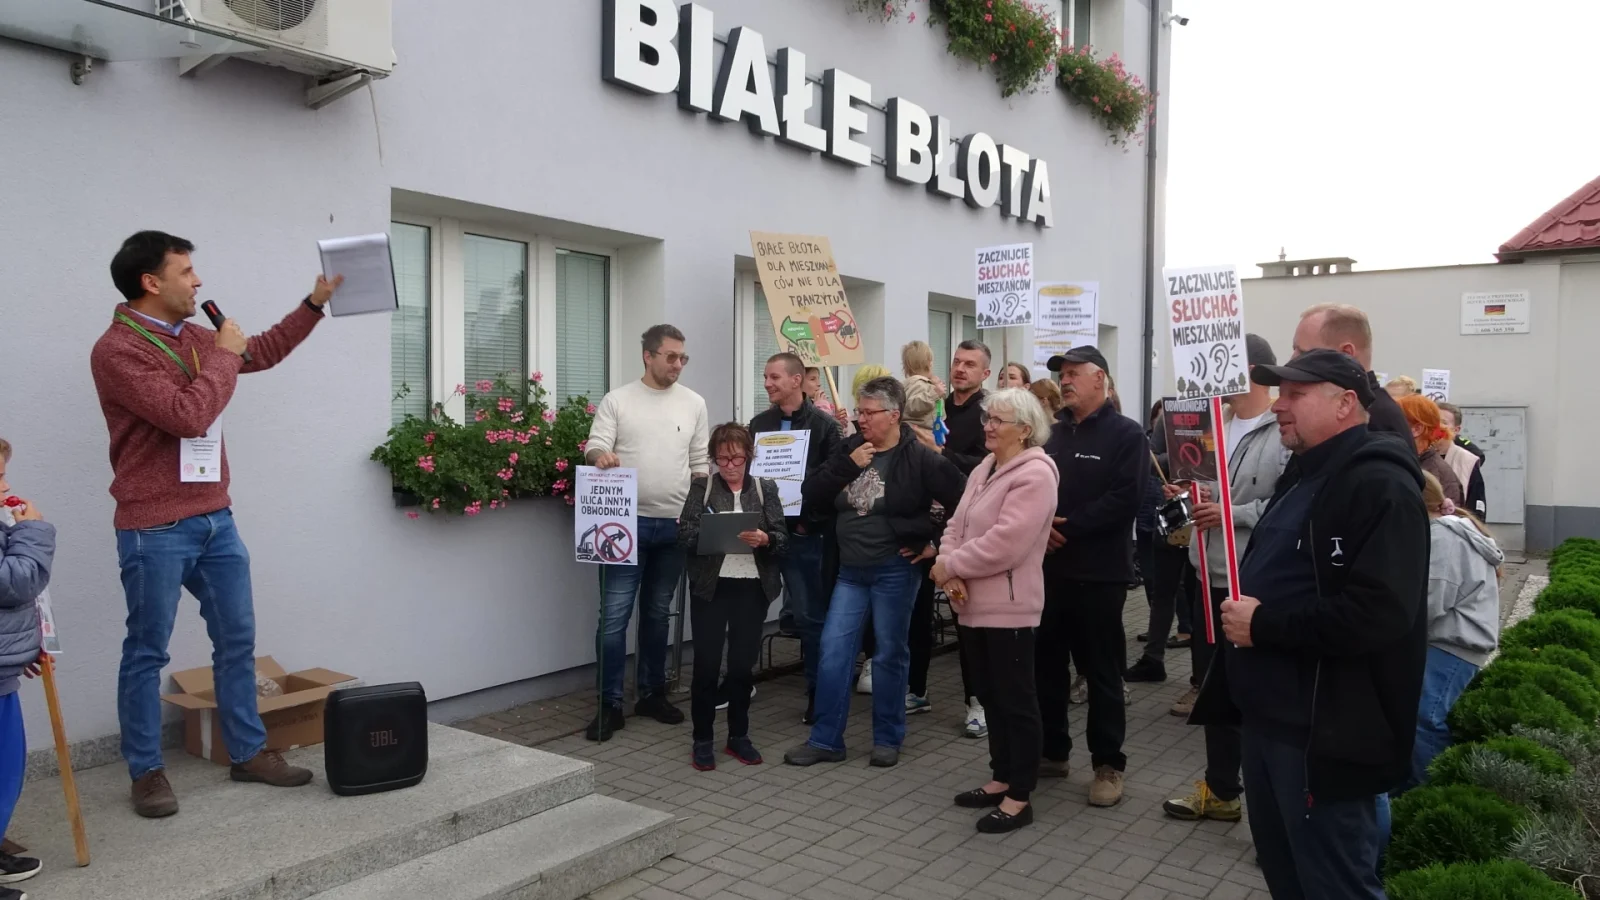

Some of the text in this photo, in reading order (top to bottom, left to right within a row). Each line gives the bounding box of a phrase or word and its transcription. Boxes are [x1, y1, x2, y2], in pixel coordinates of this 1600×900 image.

[604, 0, 1054, 228] BIAŁE BŁOTA
[756, 241, 821, 256] BIAŁE BŁOTA
[977, 247, 1030, 265] ZACZNIJCIE
[767, 261, 786, 271] DLA
[978, 260, 1030, 281] SŁUCHAĆ
[774, 275, 840, 290] CÓW NIE DLA
[977, 278, 1031, 295] MIESZKAŃCÓW
[1168, 270, 1236, 296] ZACZNIJCIE
[1172, 290, 1238, 323] SŁUCHAĆ
[1172, 319, 1241, 347] MIESZKAŃCÓW
[590, 485, 623, 496] JEDNYM
[580, 496, 631, 506] ULICA INNYM
[581, 505, 630, 517] OBWODNICA
[369, 729, 398, 747] JBL
